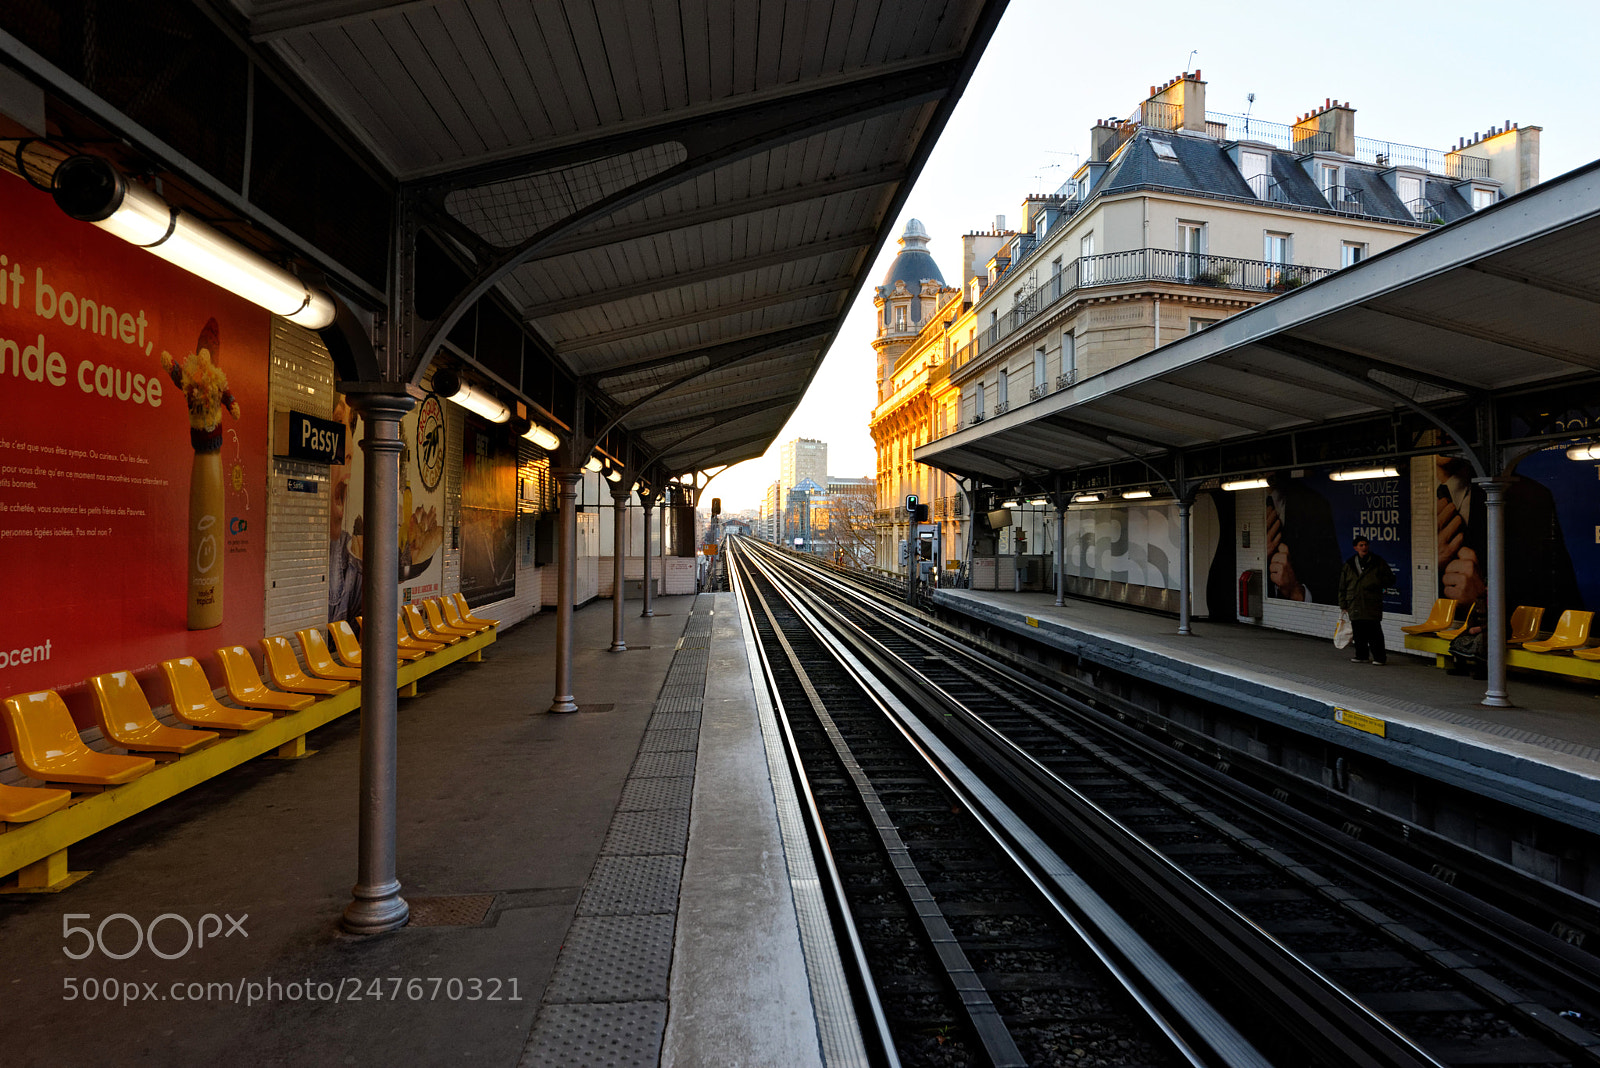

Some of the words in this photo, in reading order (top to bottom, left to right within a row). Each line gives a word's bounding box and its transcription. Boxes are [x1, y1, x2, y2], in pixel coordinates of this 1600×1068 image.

[36, 267, 153, 356] bonnet,
[77, 360, 162, 407] cause
[302, 419, 339, 460] Passy
[27, 443, 39, 453] que
[41, 446, 54, 454] vous
[89, 450, 98, 459] Ou
[2, 465, 17, 475] pour
[18, 467, 33, 475] vous
[34, 466, 46, 475] dire
[66, 470, 73, 478] ce
[1352, 480, 1399, 496] TROUVEZ
[1366, 495, 1399, 509] VOTRE
[1360, 510, 1400, 525] FUTUR
[1, 529, 33, 539] personnes
[1353, 526, 1400, 541] EMPLOI.
